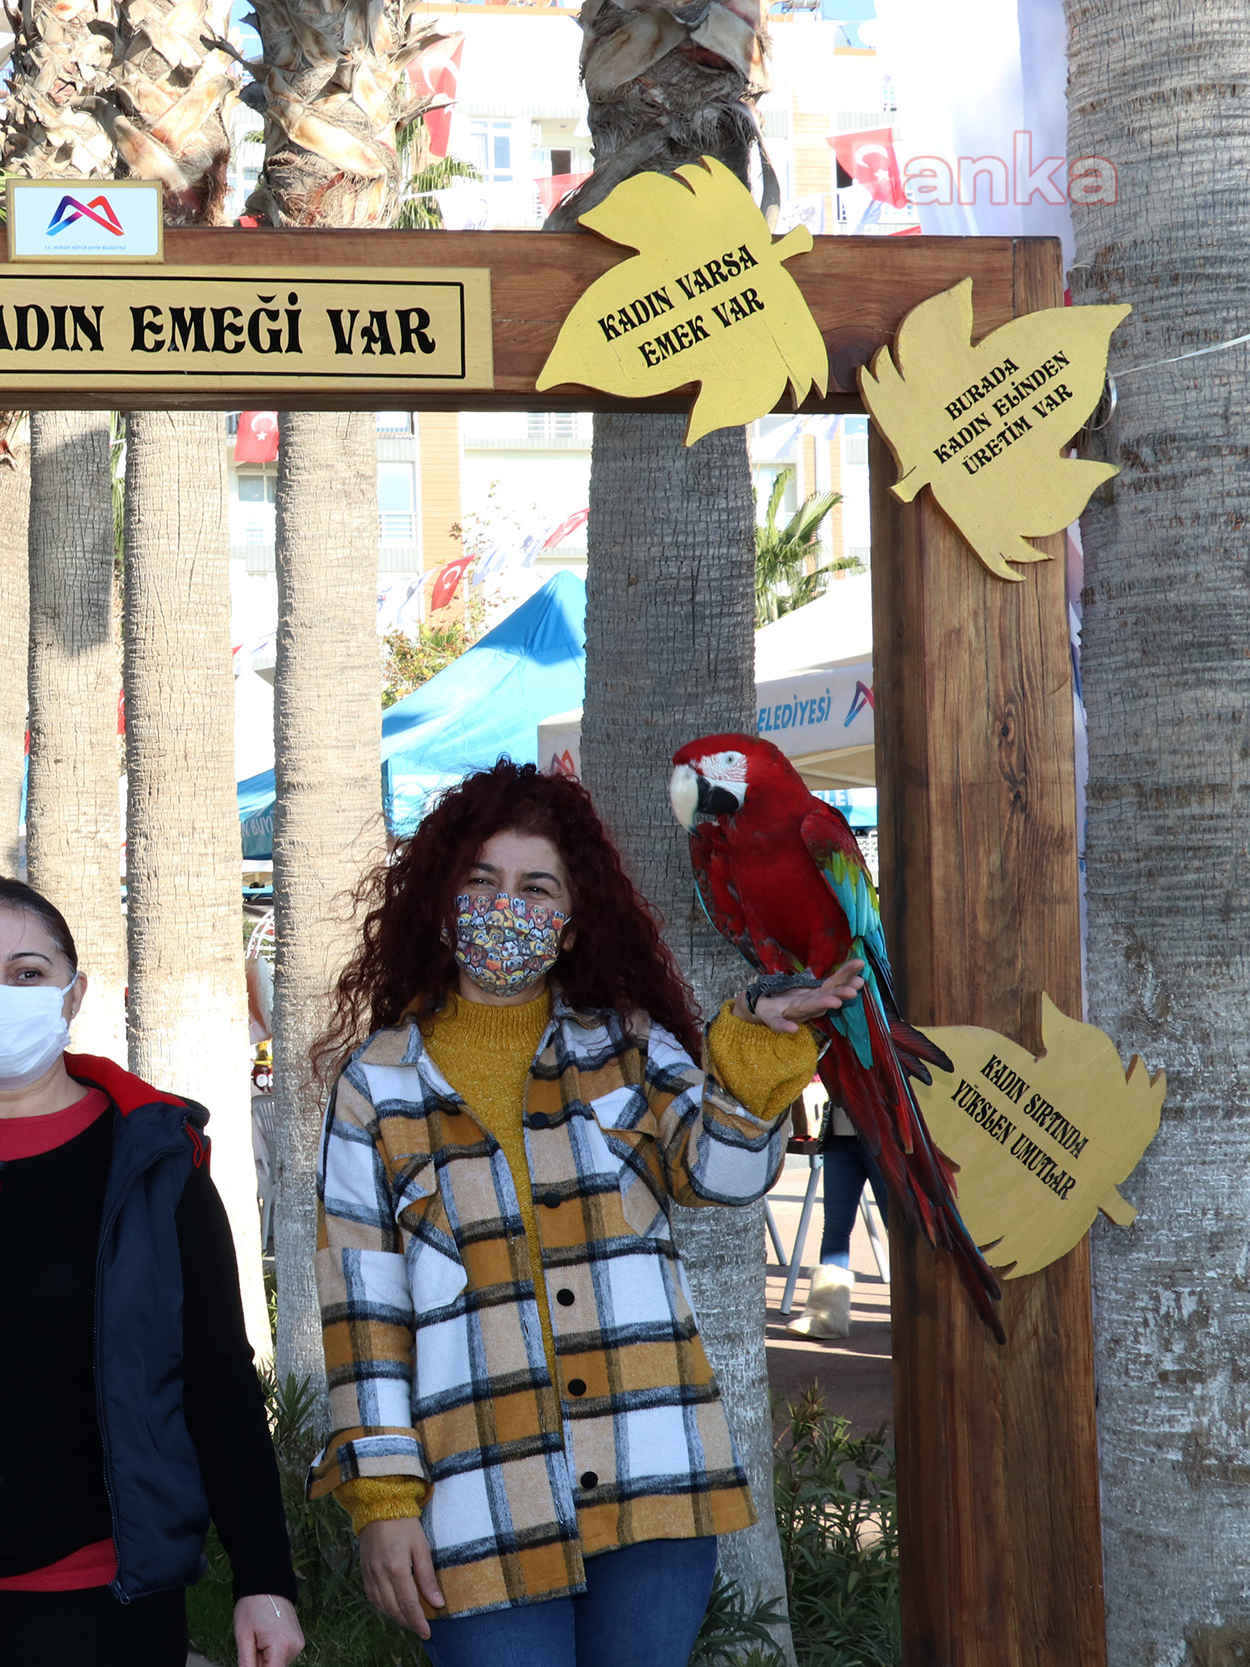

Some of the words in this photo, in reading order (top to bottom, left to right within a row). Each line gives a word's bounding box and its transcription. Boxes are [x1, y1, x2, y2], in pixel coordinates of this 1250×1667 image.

[129, 291, 303, 355] EMEĞİ
[325, 307, 436, 356] VAR
[597, 286, 675, 343] KADIN
[675, 244, 759, 300] VARSA
[637, 315, 710, 368] EMEK
[711, 287, 765, 329] VAR
[933, 412, 992, 465] KADIN
[992, 350, 1071, 417] ELİNDEN
[944, 357, 1020, 421] BURADA
[961, 415, 1033, 475] ÜRETİM
[1032, 383, 1074, 419] VAR
[755, 687, 831, 732] ELEDİYESİ
[980, 1054, 1031, 1104] KADIN
[1023, 1093, 1089, 1160] SIRTINDA
[1010, 1133, 1076, 1200] UMUTLAR
